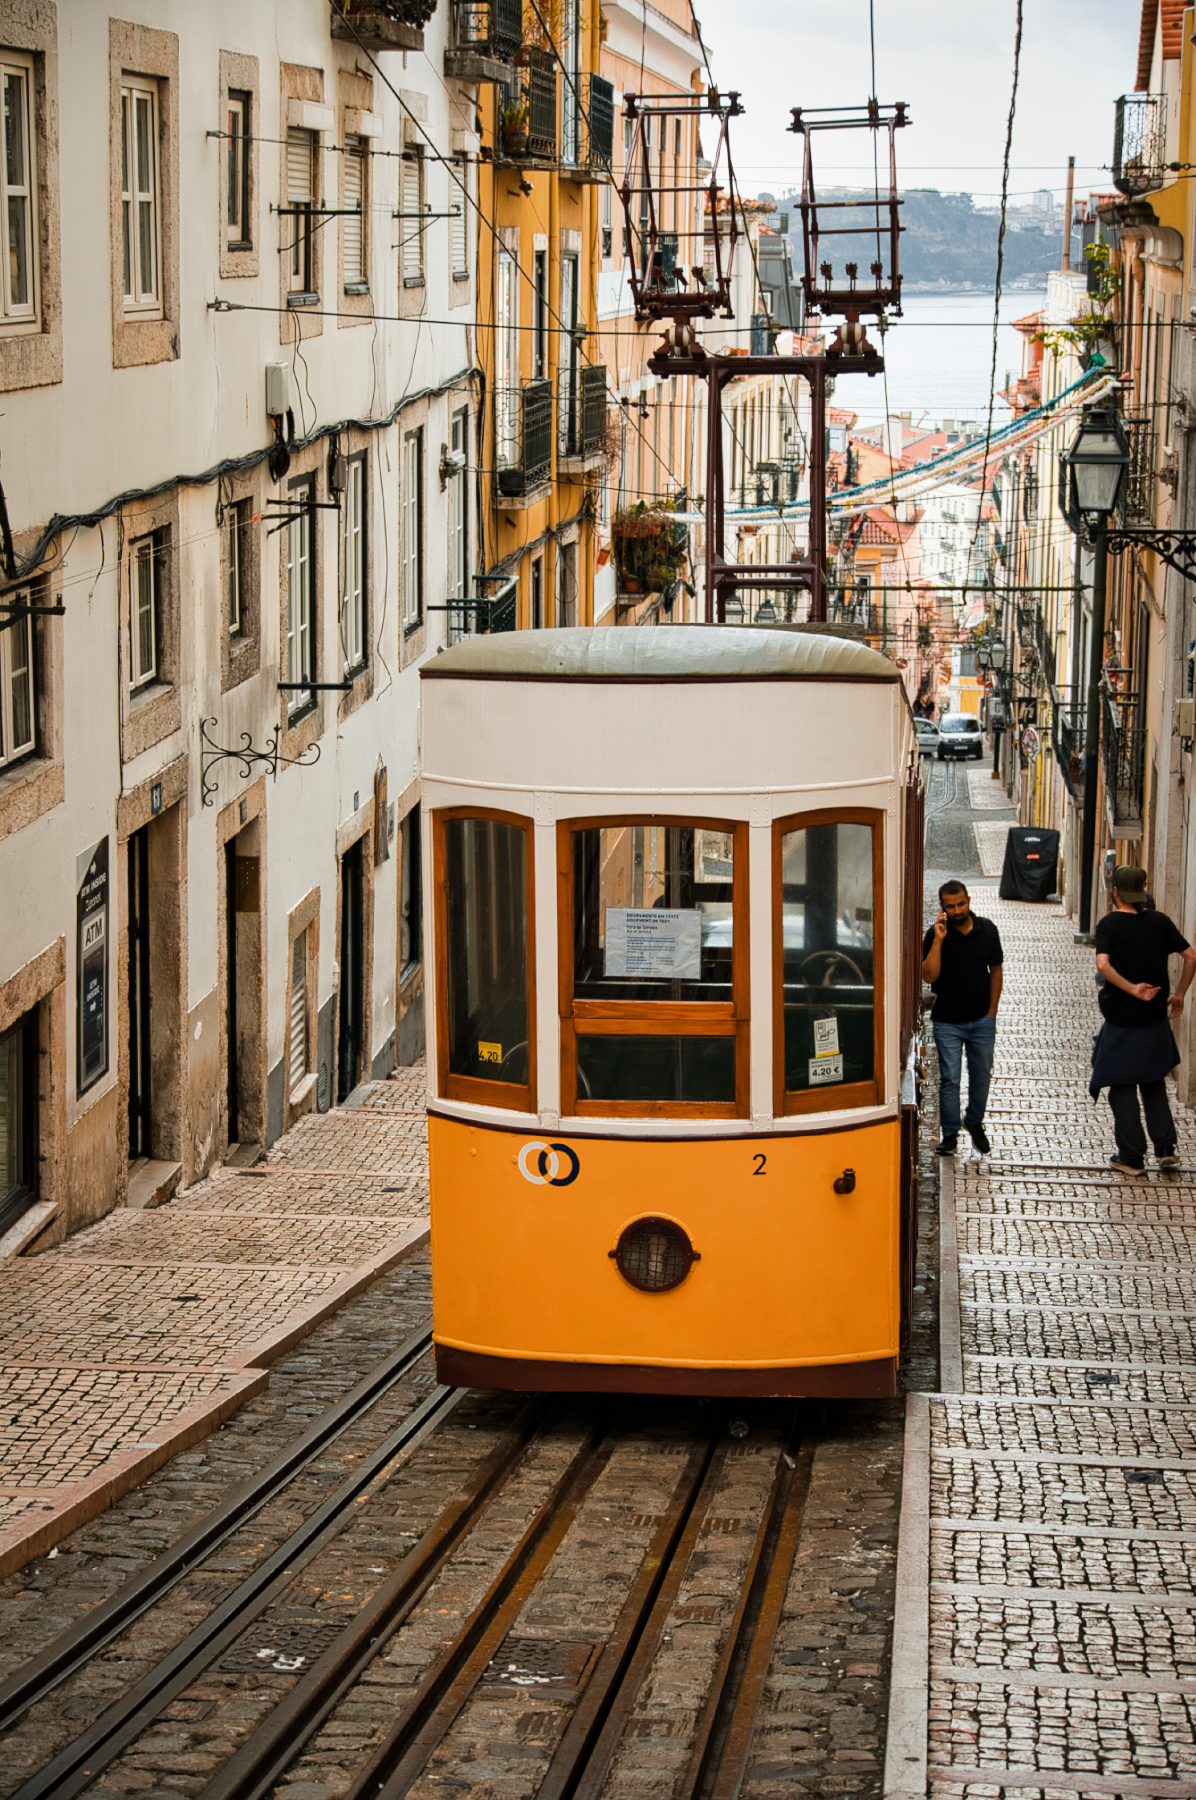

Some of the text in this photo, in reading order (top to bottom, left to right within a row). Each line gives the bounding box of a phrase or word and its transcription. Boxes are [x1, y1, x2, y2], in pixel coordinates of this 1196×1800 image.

[91, 872, 107, 891] INSIDE
[85, 917, 103, 947] ATM
[812, 1066, 840, 1076] 4.20 €
[752, 1153, 768, 1176] 2
